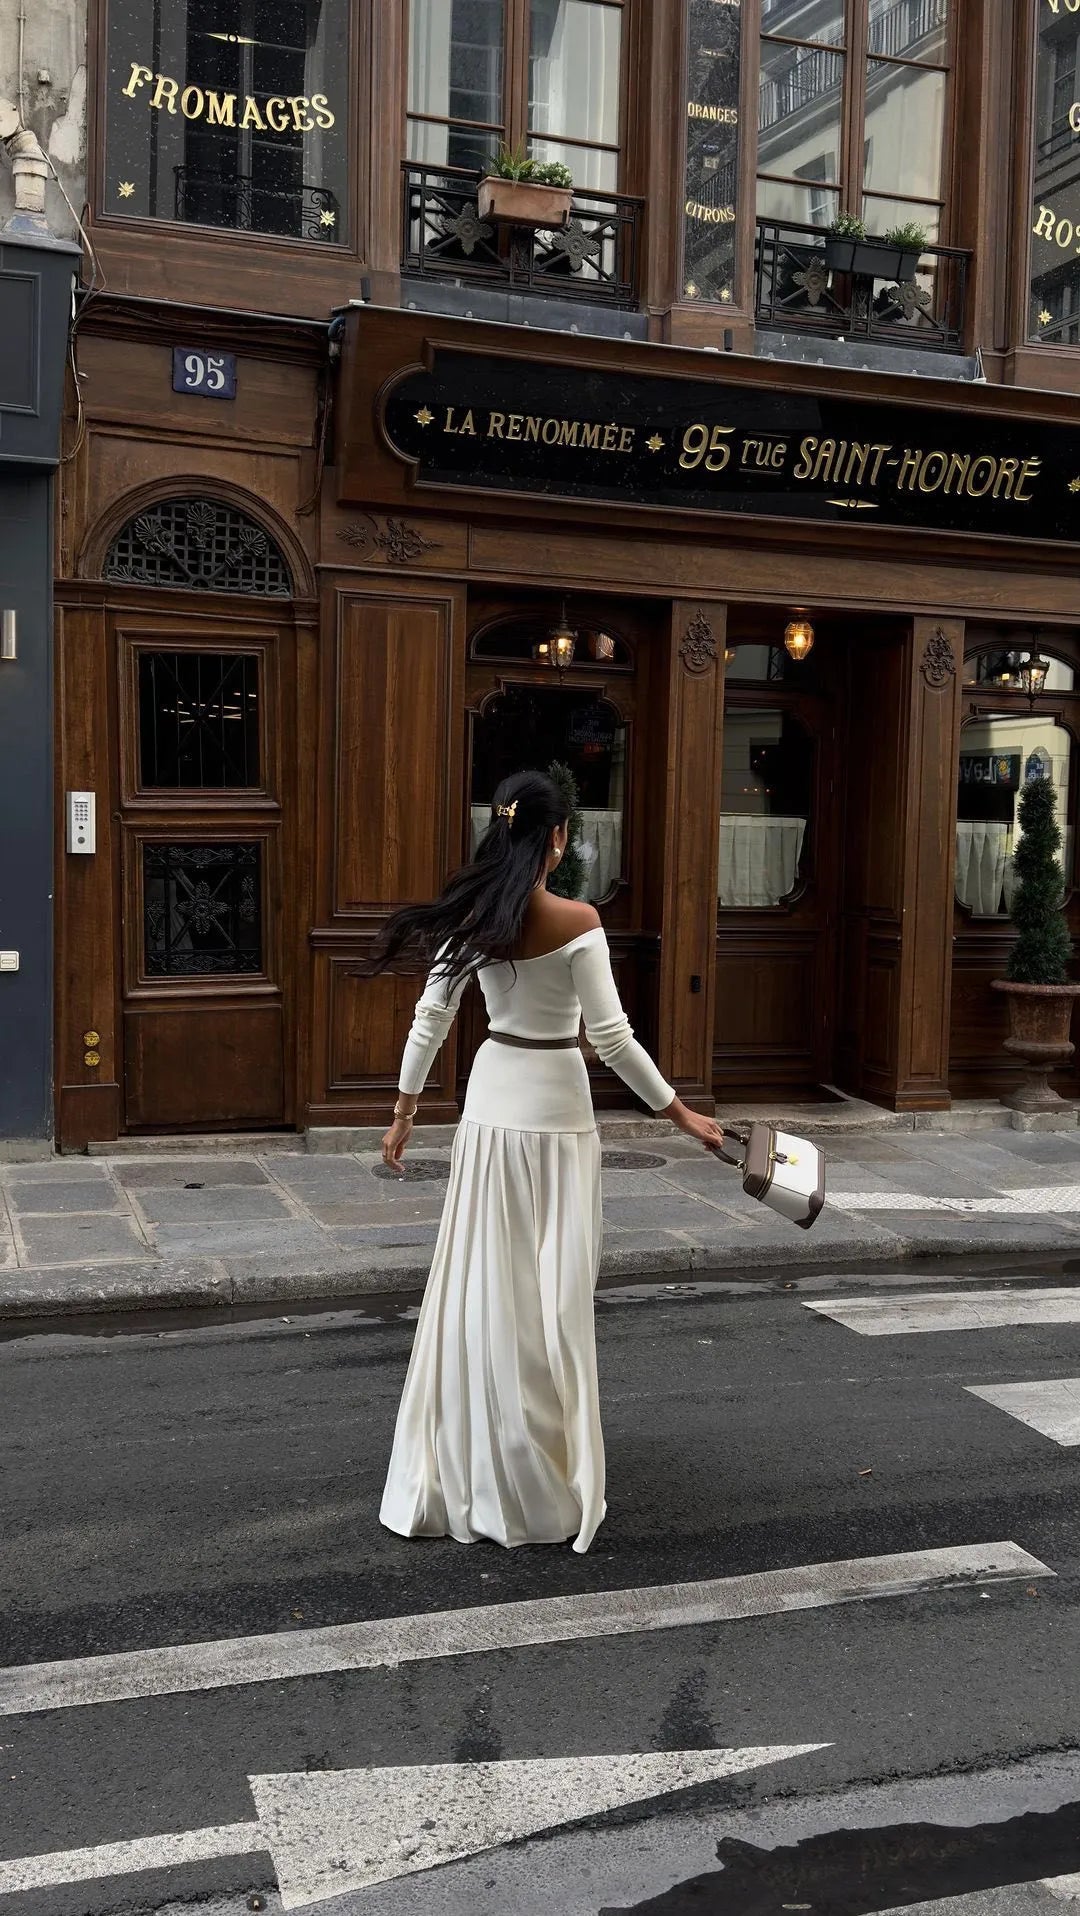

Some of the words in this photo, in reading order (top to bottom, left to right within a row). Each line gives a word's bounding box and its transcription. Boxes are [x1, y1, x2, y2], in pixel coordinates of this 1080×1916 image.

[121, 62, 335, 132] FROMAGES
[687, 102, 738, 124] ORANGES
[686, 201, 736, 223] CITRONS
[1033, 205, 1080, 253] RO
[184, 355, 225, 390] 95
[443, 407, 477, 435] LA
[486, 411, 635, 453] RENOMMÉE
[678, 423, 736, 471] 95
[740, 437, 787, 468] rue
[793, 435, 1043, 501] SAINT-HONORÉ
